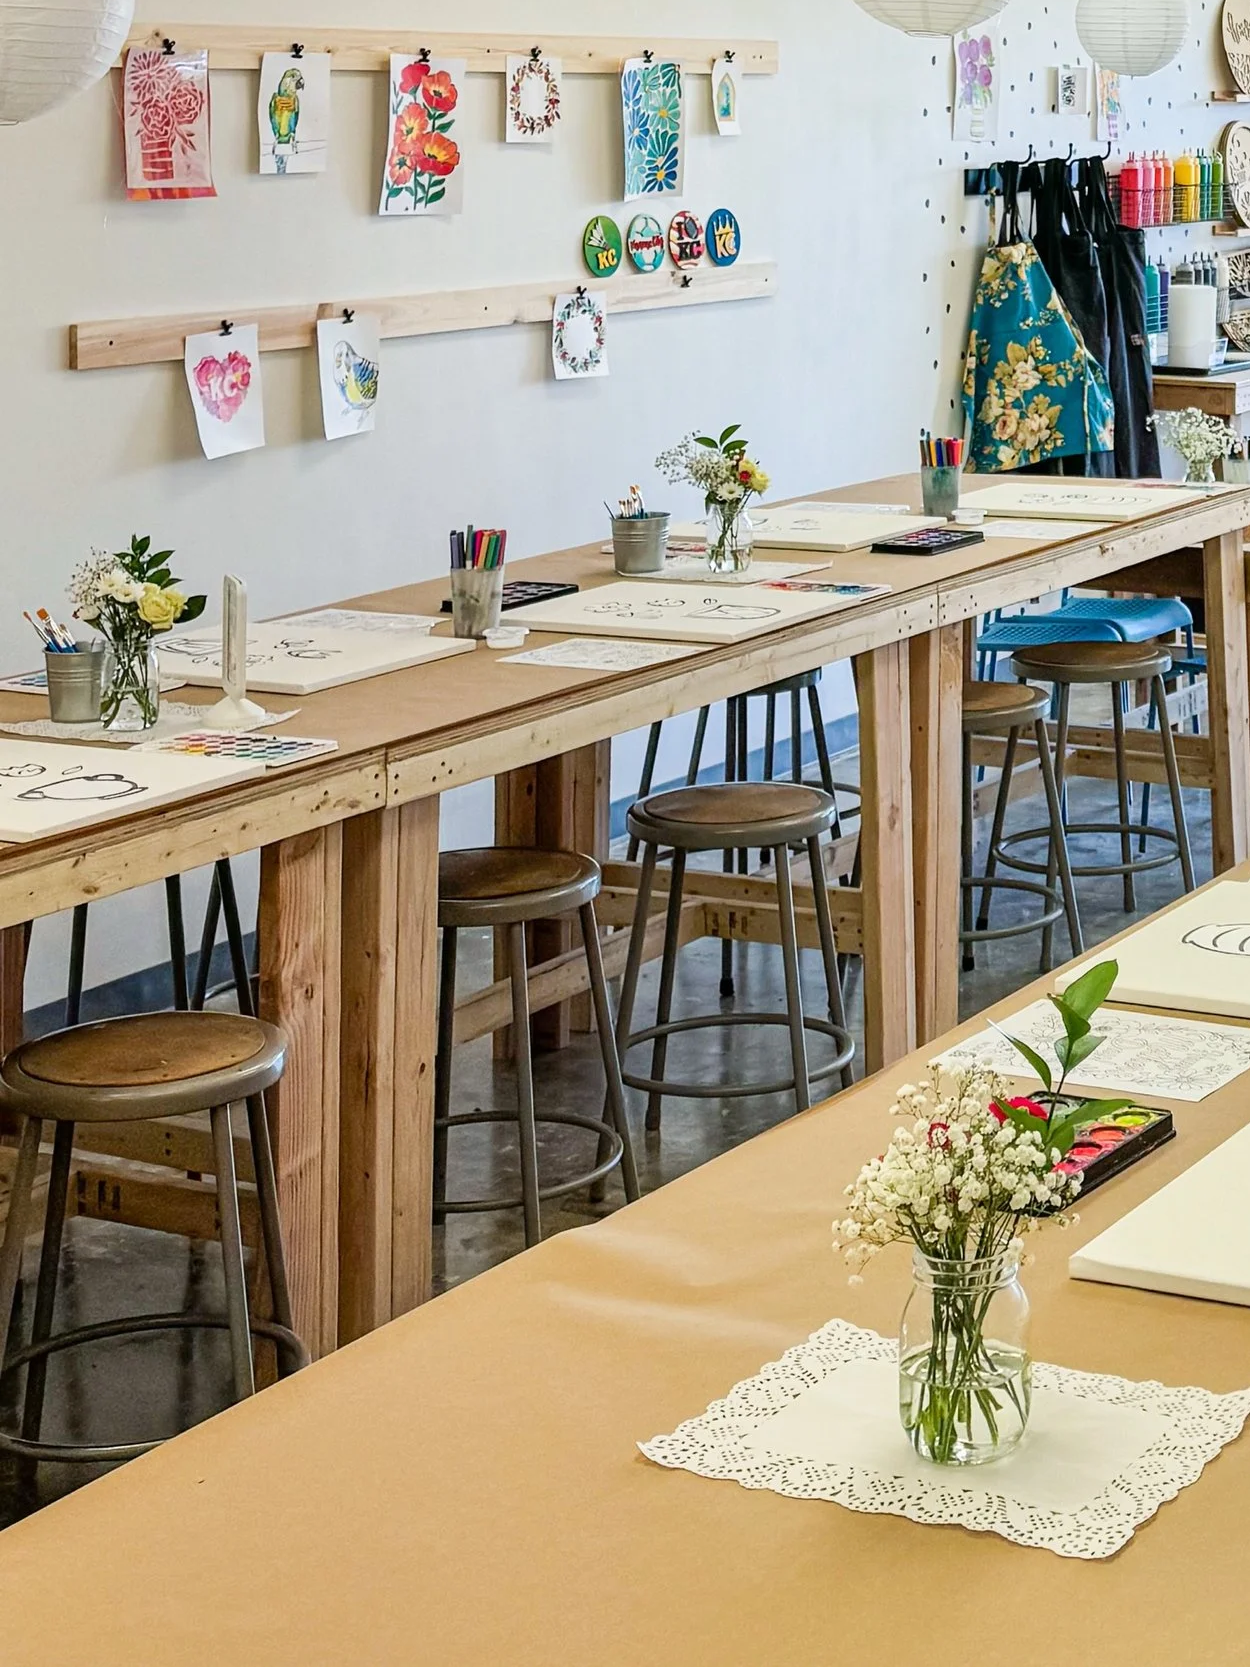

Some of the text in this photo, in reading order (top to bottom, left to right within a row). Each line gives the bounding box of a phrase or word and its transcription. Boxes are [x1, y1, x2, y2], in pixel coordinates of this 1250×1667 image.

[678, 240, 703, 261] KC
[715, 232, 737, 258] KC
[597, 248, 618, 270] KC
